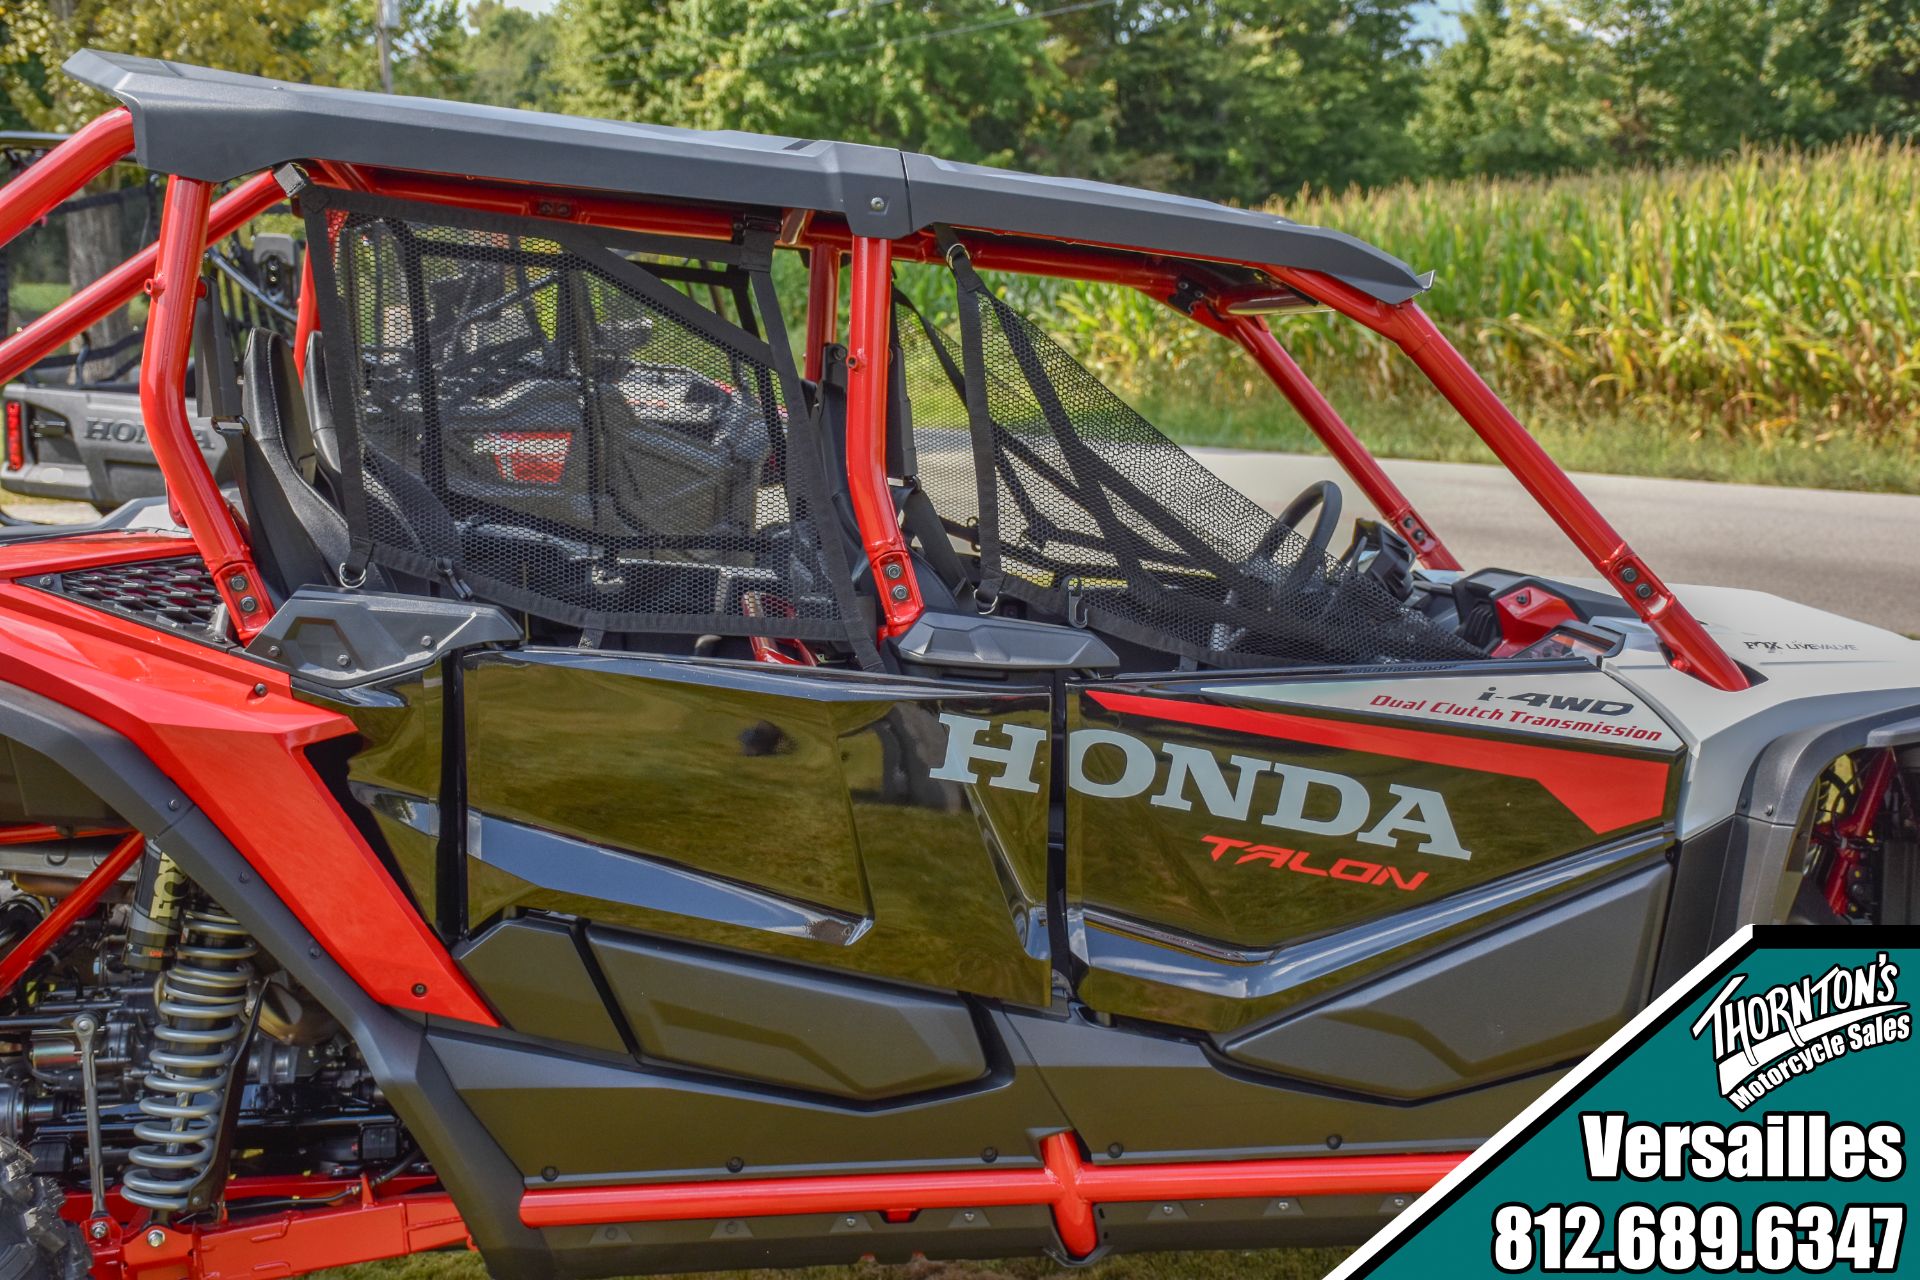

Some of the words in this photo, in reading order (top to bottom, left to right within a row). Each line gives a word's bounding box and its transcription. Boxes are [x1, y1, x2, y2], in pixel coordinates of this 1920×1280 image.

[84, 420, 215, 450] HOA
[1369, 694, 1427, 711] Dual
[1430, 701, 1504, 721] Clutch
[1508, 710, 1663, 742] Transmission
[1478, 686, 1634, 717] i-4WD
[929, 712, 1472, 860] HONDA
[1201, 834, 1429, 890] TALON
